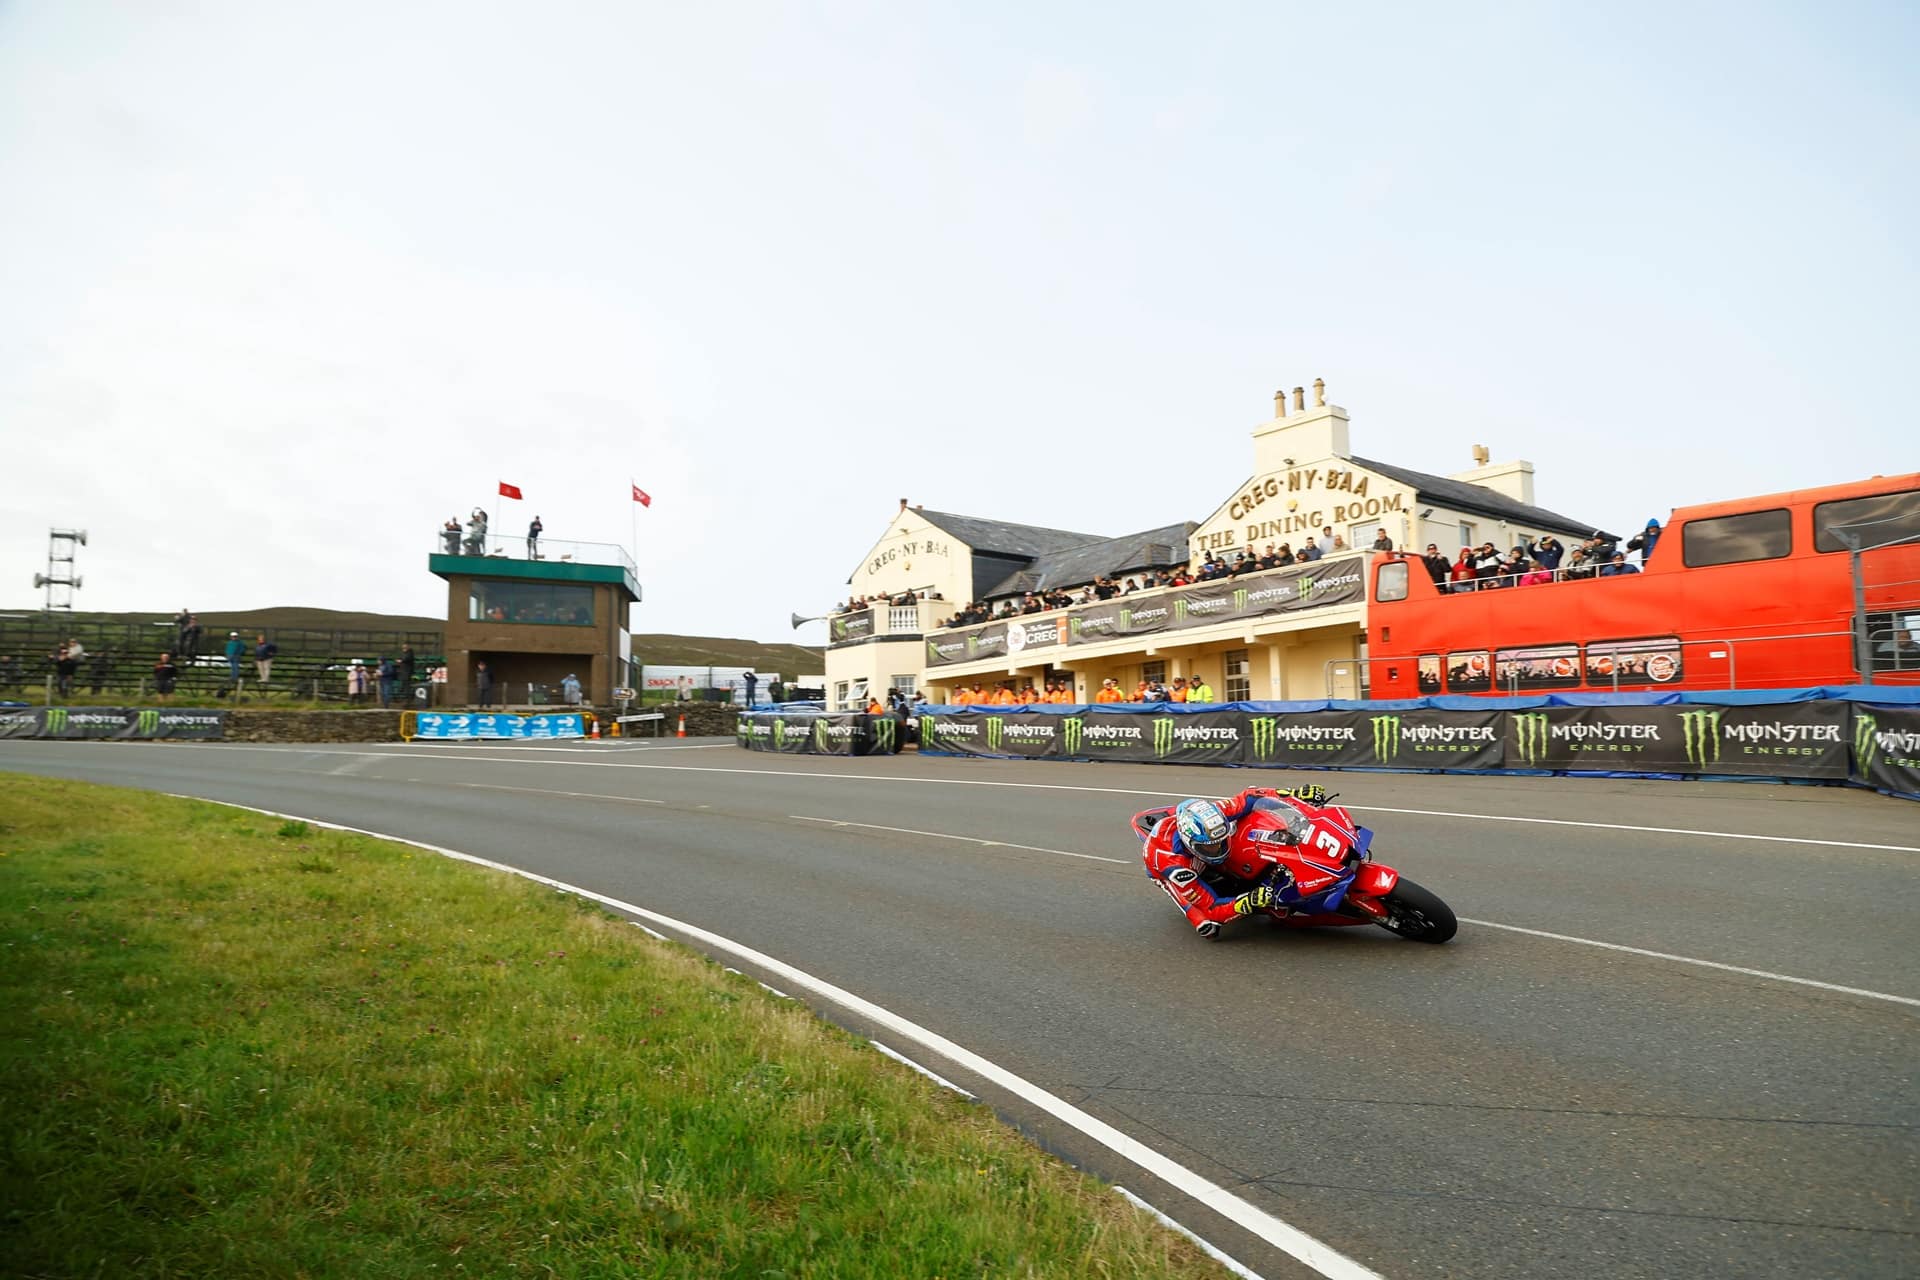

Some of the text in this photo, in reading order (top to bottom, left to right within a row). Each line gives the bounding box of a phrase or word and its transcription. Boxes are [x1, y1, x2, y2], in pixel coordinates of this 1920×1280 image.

[1198, 493, 1403, 551] THE DINING ROOM
[1313, 574, 1361, 589] MONSTER
[1027, 630, 1057, 644] CREG
[935, 722, 979, 735] MONSTER
[1003, 723, 1055, 737] MONSTER
[1083, 725, 1142, 739] MONSTER
[1174, 725, 1239, 740] MONSTER
[1277, 725, 1356, 742] MONSTER
[1401, 724, 1497, 743] MONSTER
[1551, 722, 1661, 741] MONSTER
[1724, 721, 1841, 743] MONSTER
[1415, 744, 1481, 752] ENERGY
[1569, 744, 1645, 752] ENERGY
[1743, 746, 1825, 756] ENERGY
[1316, 830, 1341, 858] 3
